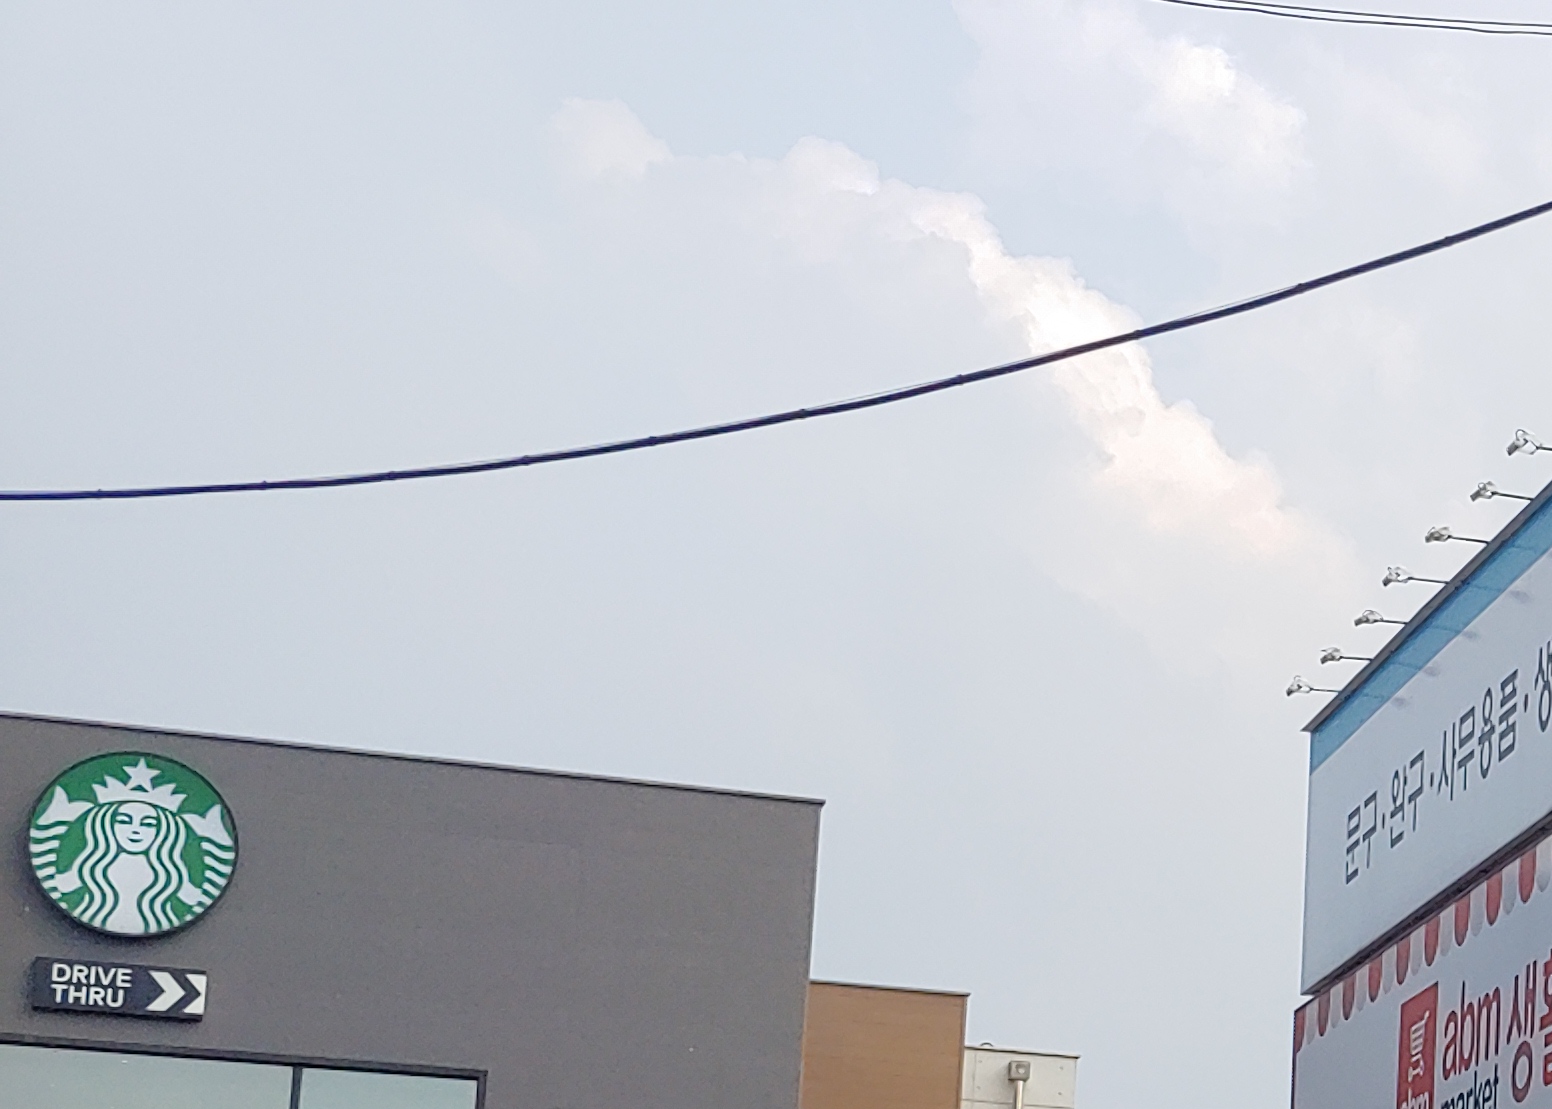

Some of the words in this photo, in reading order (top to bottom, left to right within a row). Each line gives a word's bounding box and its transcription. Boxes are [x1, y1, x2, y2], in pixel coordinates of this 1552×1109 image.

[1346, 791, 1377, 884] 문구
[1389, 749, 1425, 848] 완구
[1438, 668, 1517, 801] 사무용품
[51, 983, 126, 1008] THRU
[52, 964, 132, 987] DRIVE
[1442, 981, 1500, 1082] abm
